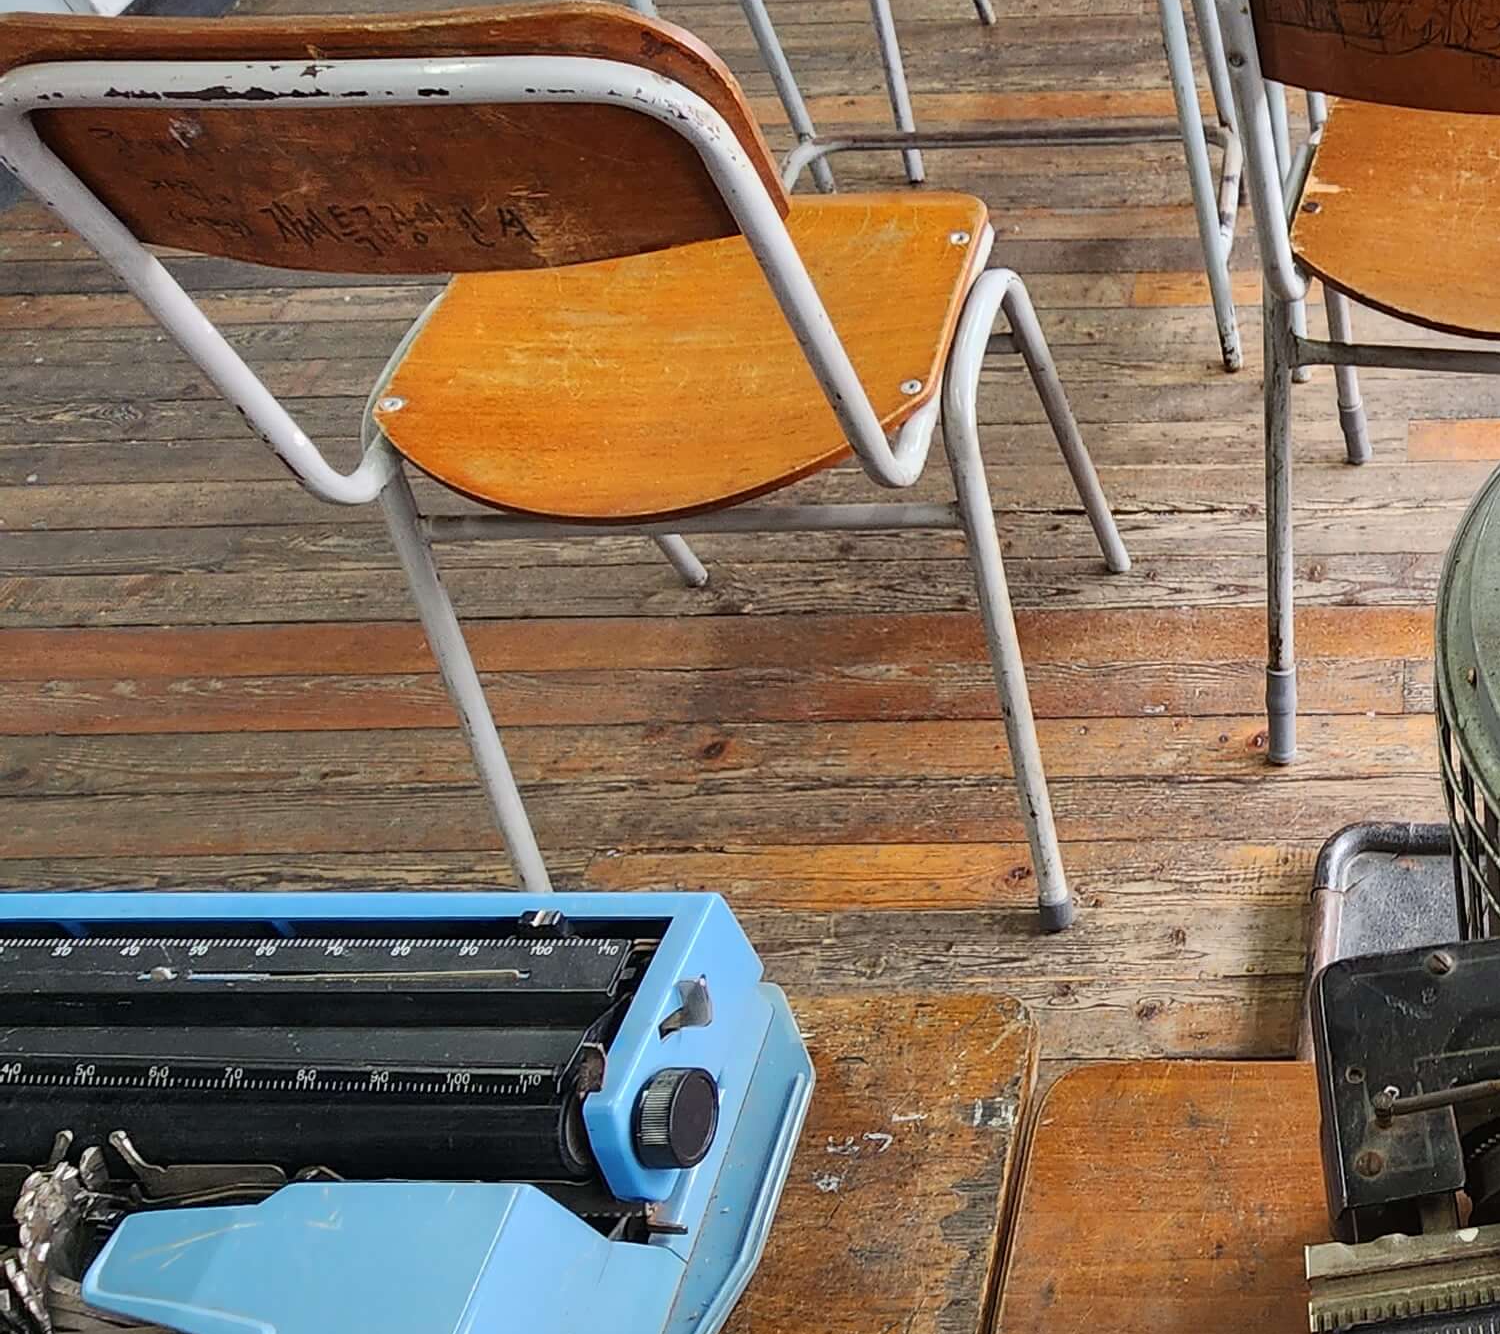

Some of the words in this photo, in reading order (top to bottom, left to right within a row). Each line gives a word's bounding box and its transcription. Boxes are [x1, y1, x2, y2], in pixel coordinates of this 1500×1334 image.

[52, 945, 72, 957] 30
[119, 945, 140, 957] 40
[188, 945, 209, 957] 50
[255, 945, 277, 957] 60
[324, 945, 344, 957] 70
[391, 945, 411, 957] 80
[459, 945, 480, 957] 90
[530, 945, 553, 957] 100
[598, 945, 619, 957] 110
